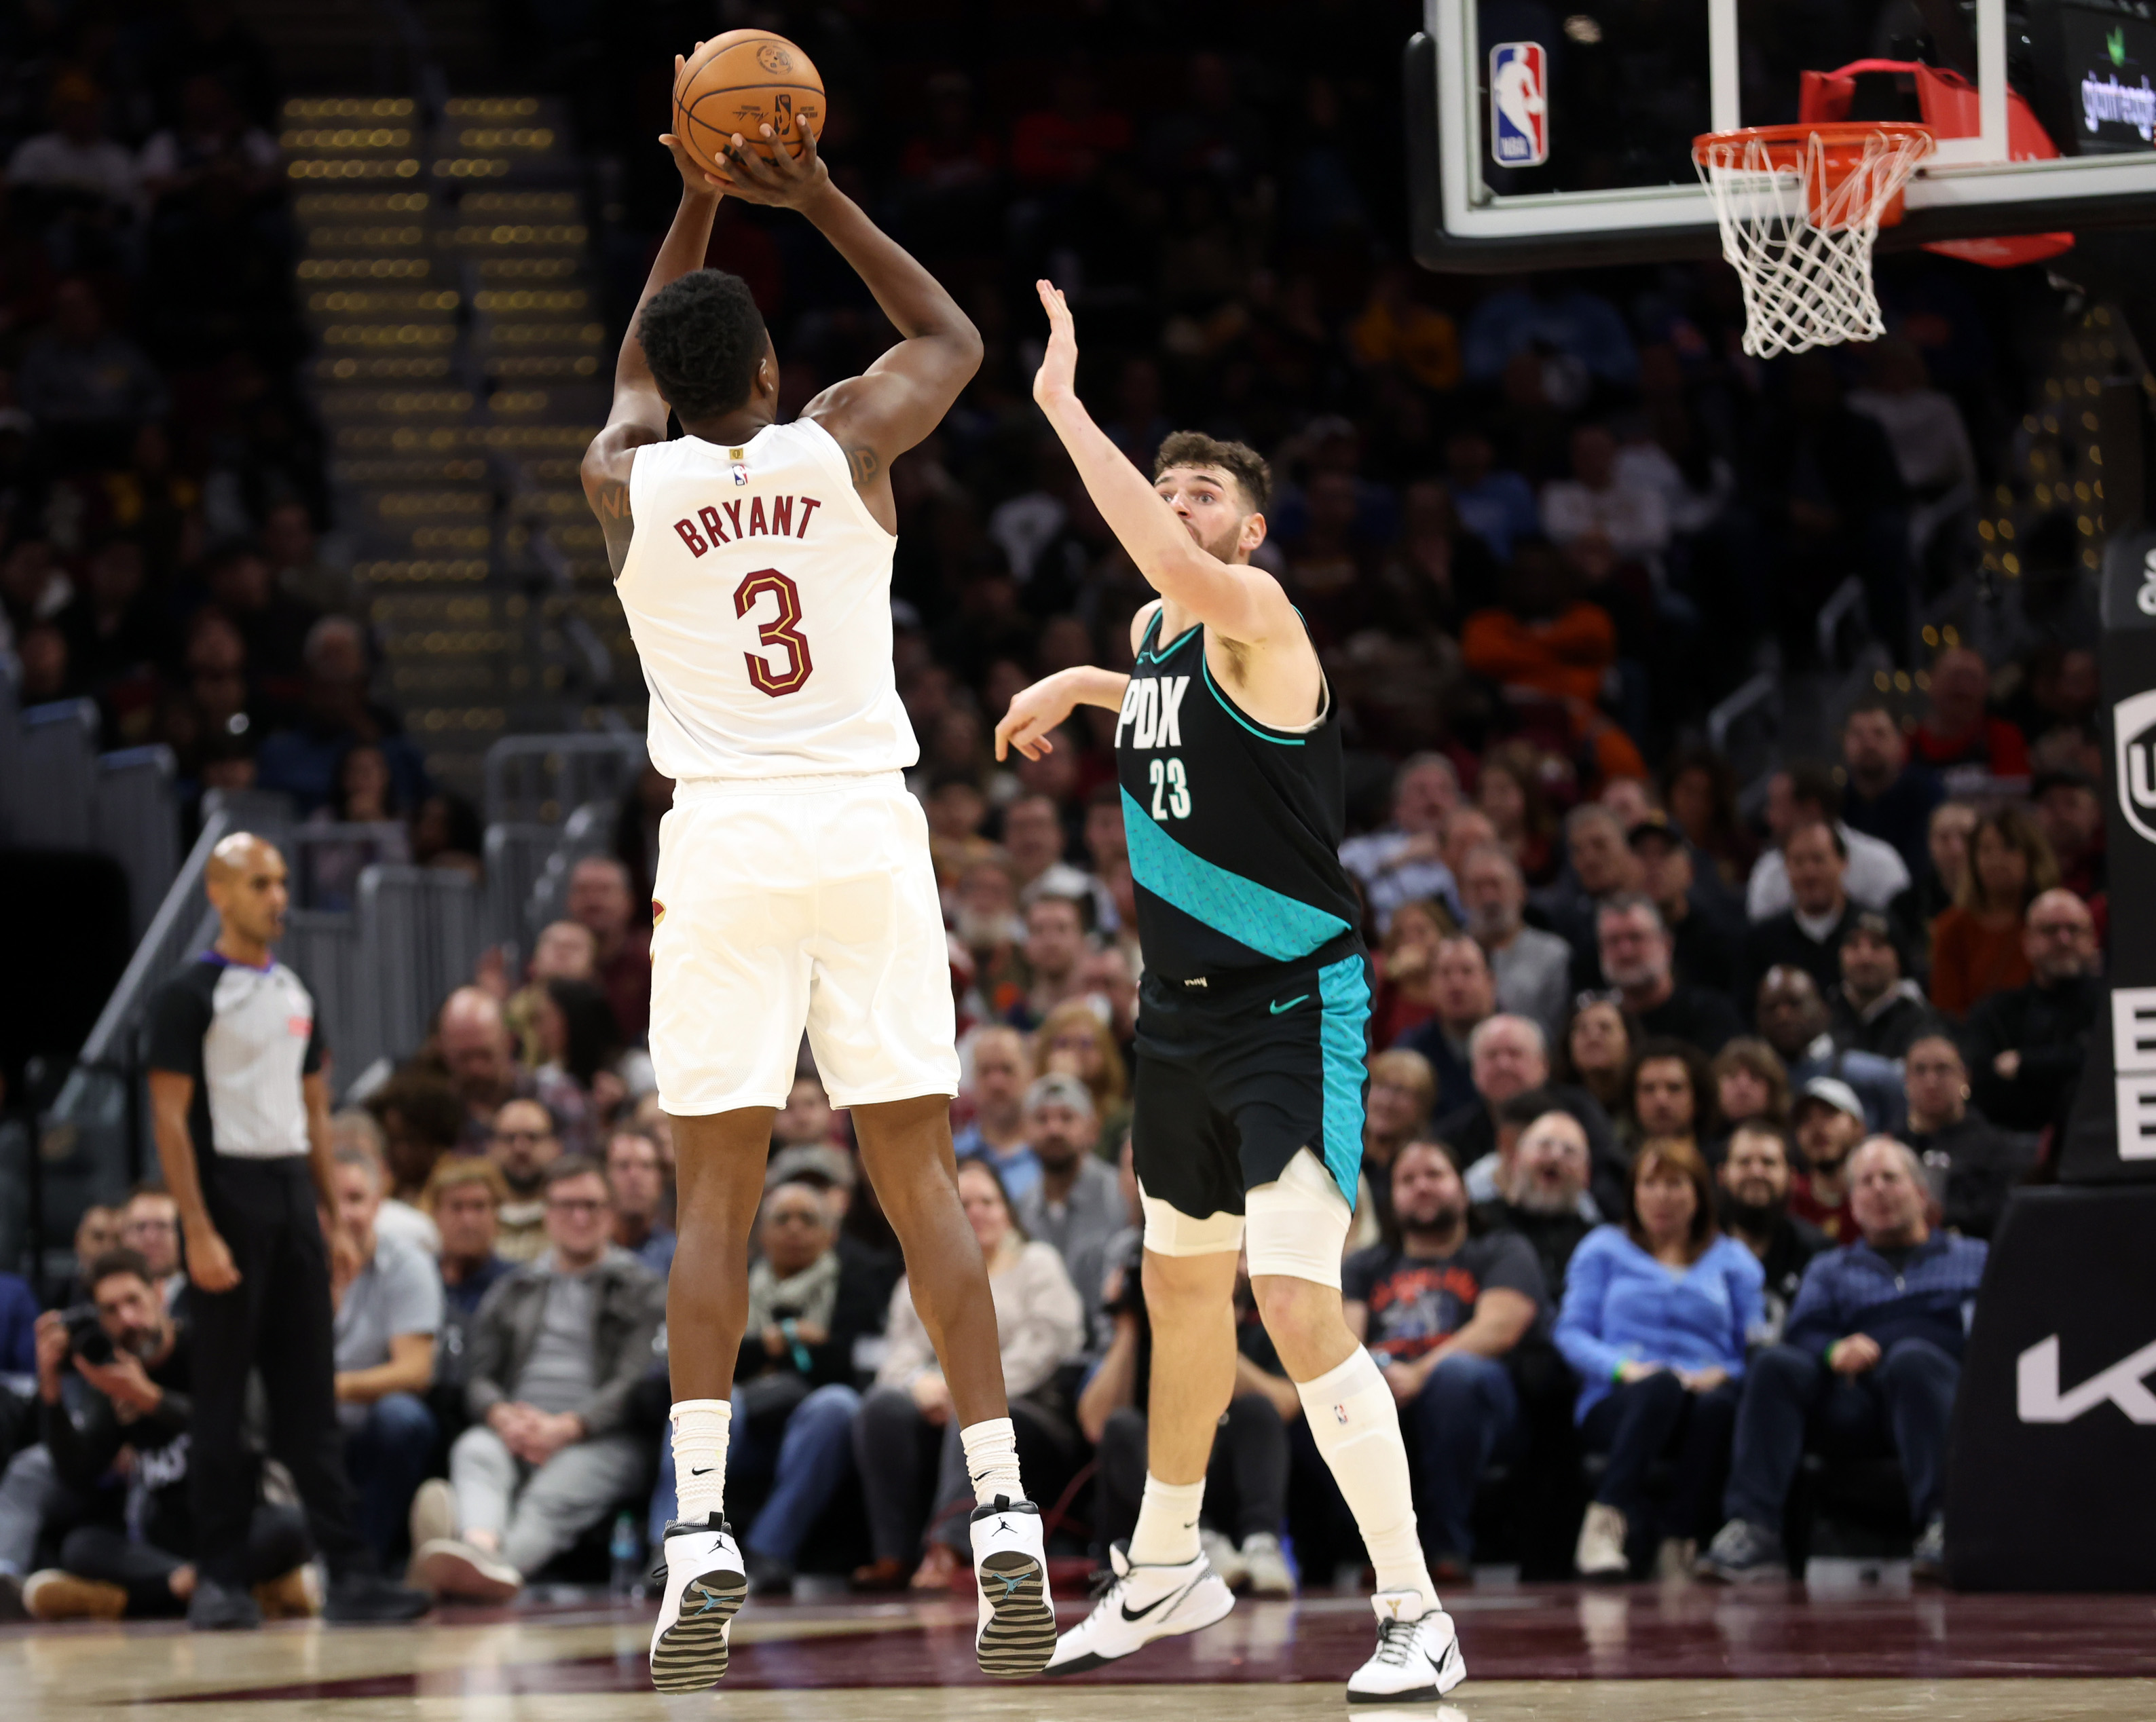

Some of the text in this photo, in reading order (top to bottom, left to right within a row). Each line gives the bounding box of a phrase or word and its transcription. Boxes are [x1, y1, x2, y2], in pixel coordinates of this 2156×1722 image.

[673, 495, 821, 558] BRYANT
[733, 568, 813, 697] 3
[1115, 676, 1190, 749] PDX
[1149, 757, 1192, 821] 23
